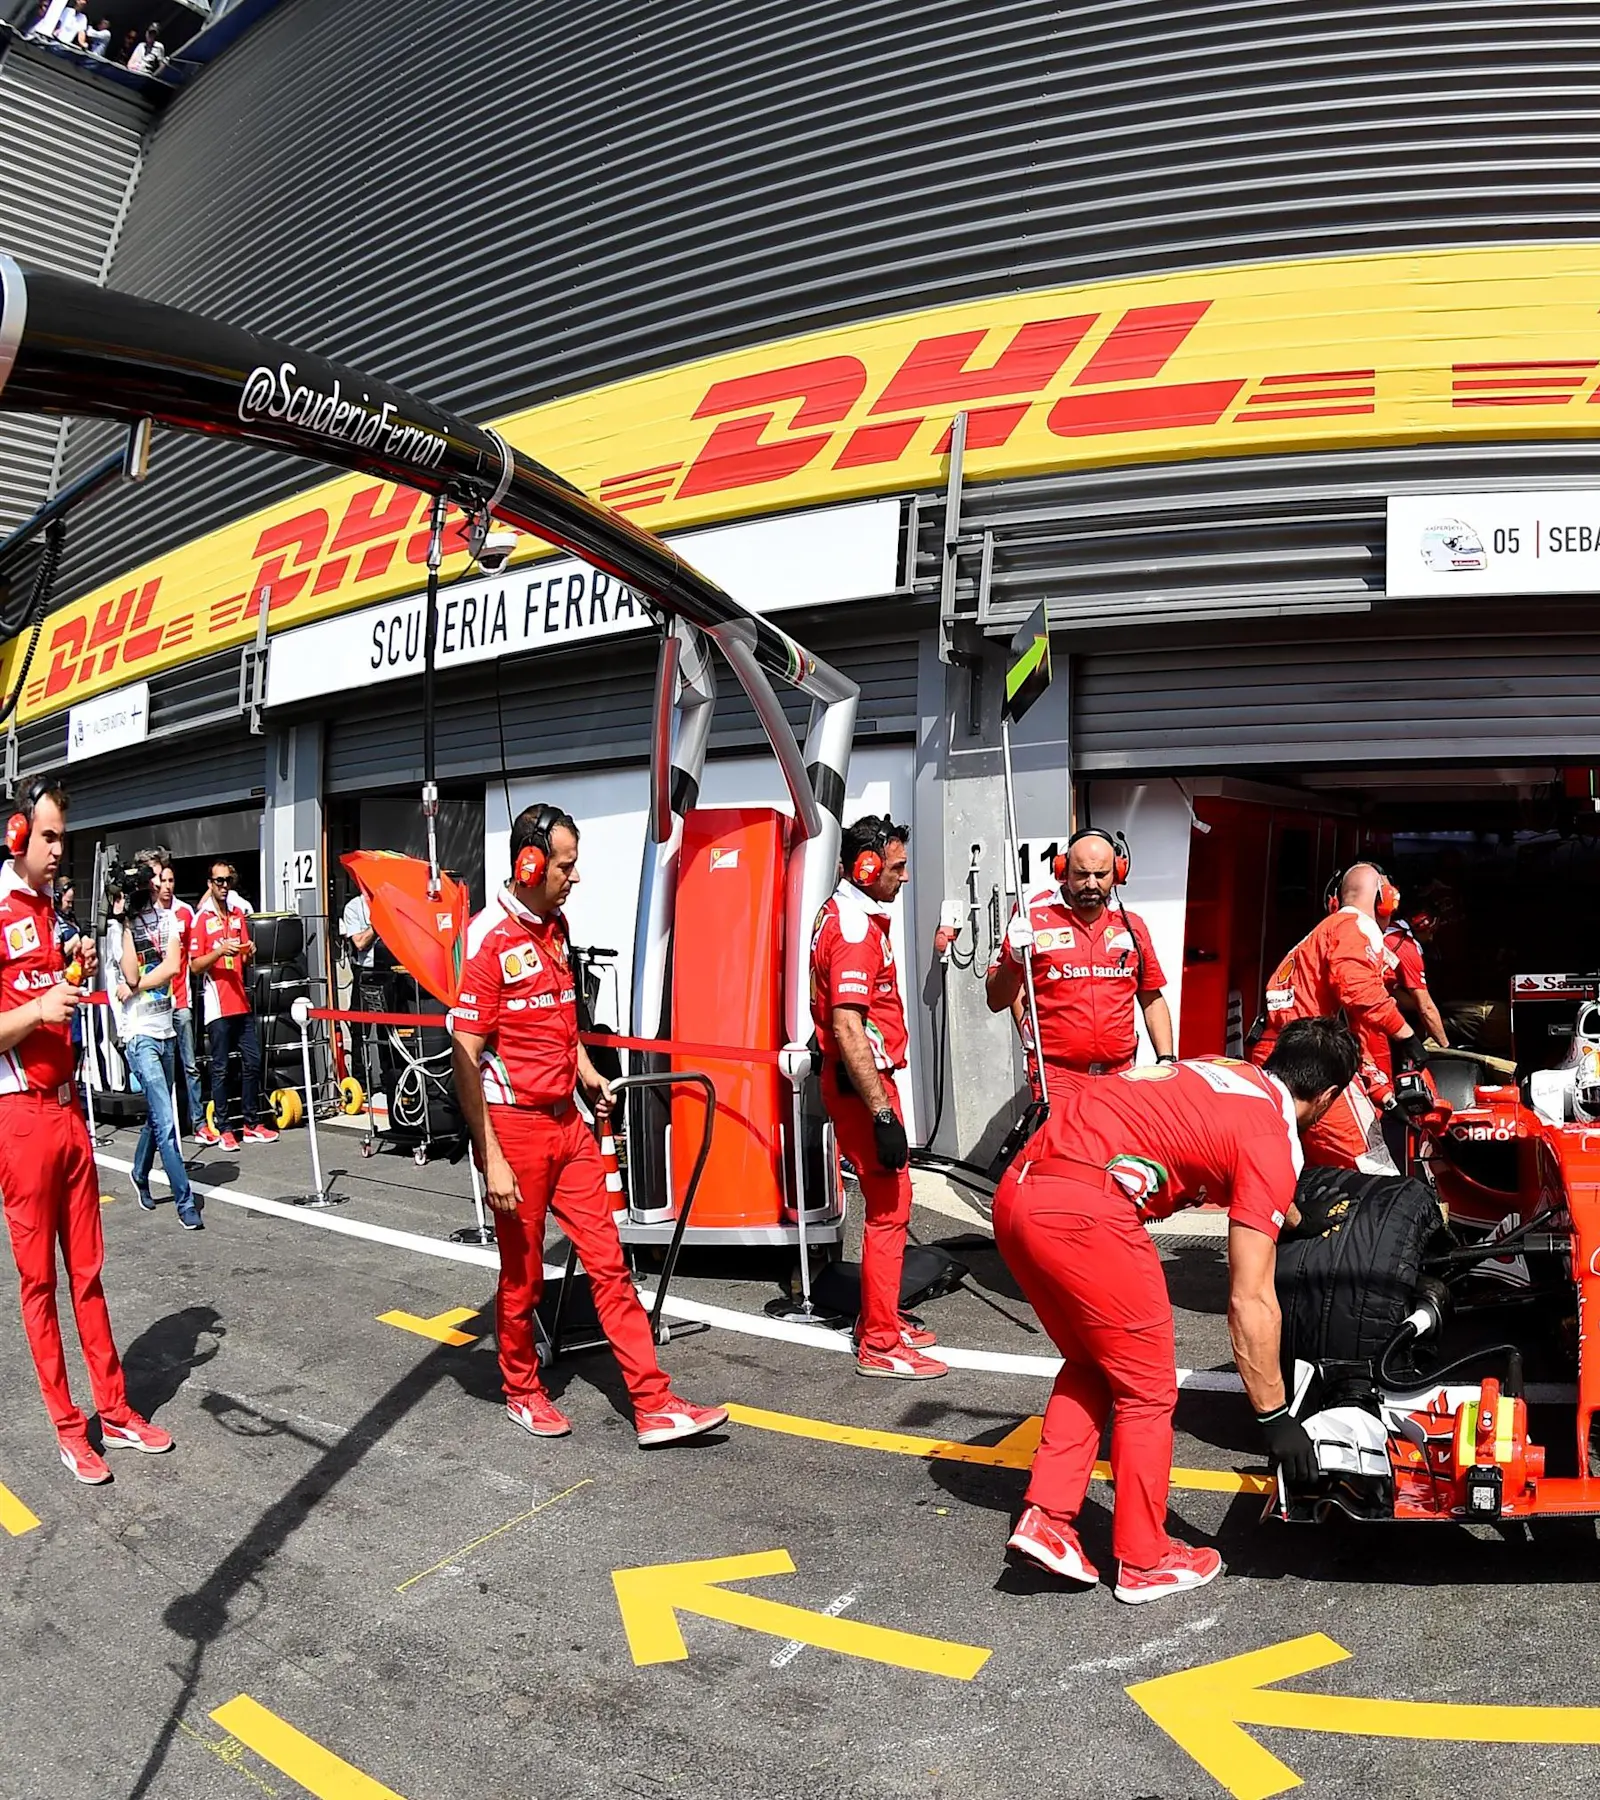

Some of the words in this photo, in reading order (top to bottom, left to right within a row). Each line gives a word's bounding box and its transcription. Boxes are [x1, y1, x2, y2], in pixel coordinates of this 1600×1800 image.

[238, 362, 449, 469] @ScuderiaFerrari
[674, 300, 1246, 498] DHL
[1493, 527, 1520, 554] 05
[43, 576, 165, 699] DHL
[370, 589, 508, 669] SCUERIA
[523, 569, 646, 637] FERRA
[294, 854, 313, 884] 12
[1062, 961, 1134, 979] Santander
[1452, 1121, 1516, 1142] Claro
[773, 1640, 801, 1665] FRO
[827, 1595, 850, 1617] XLE
